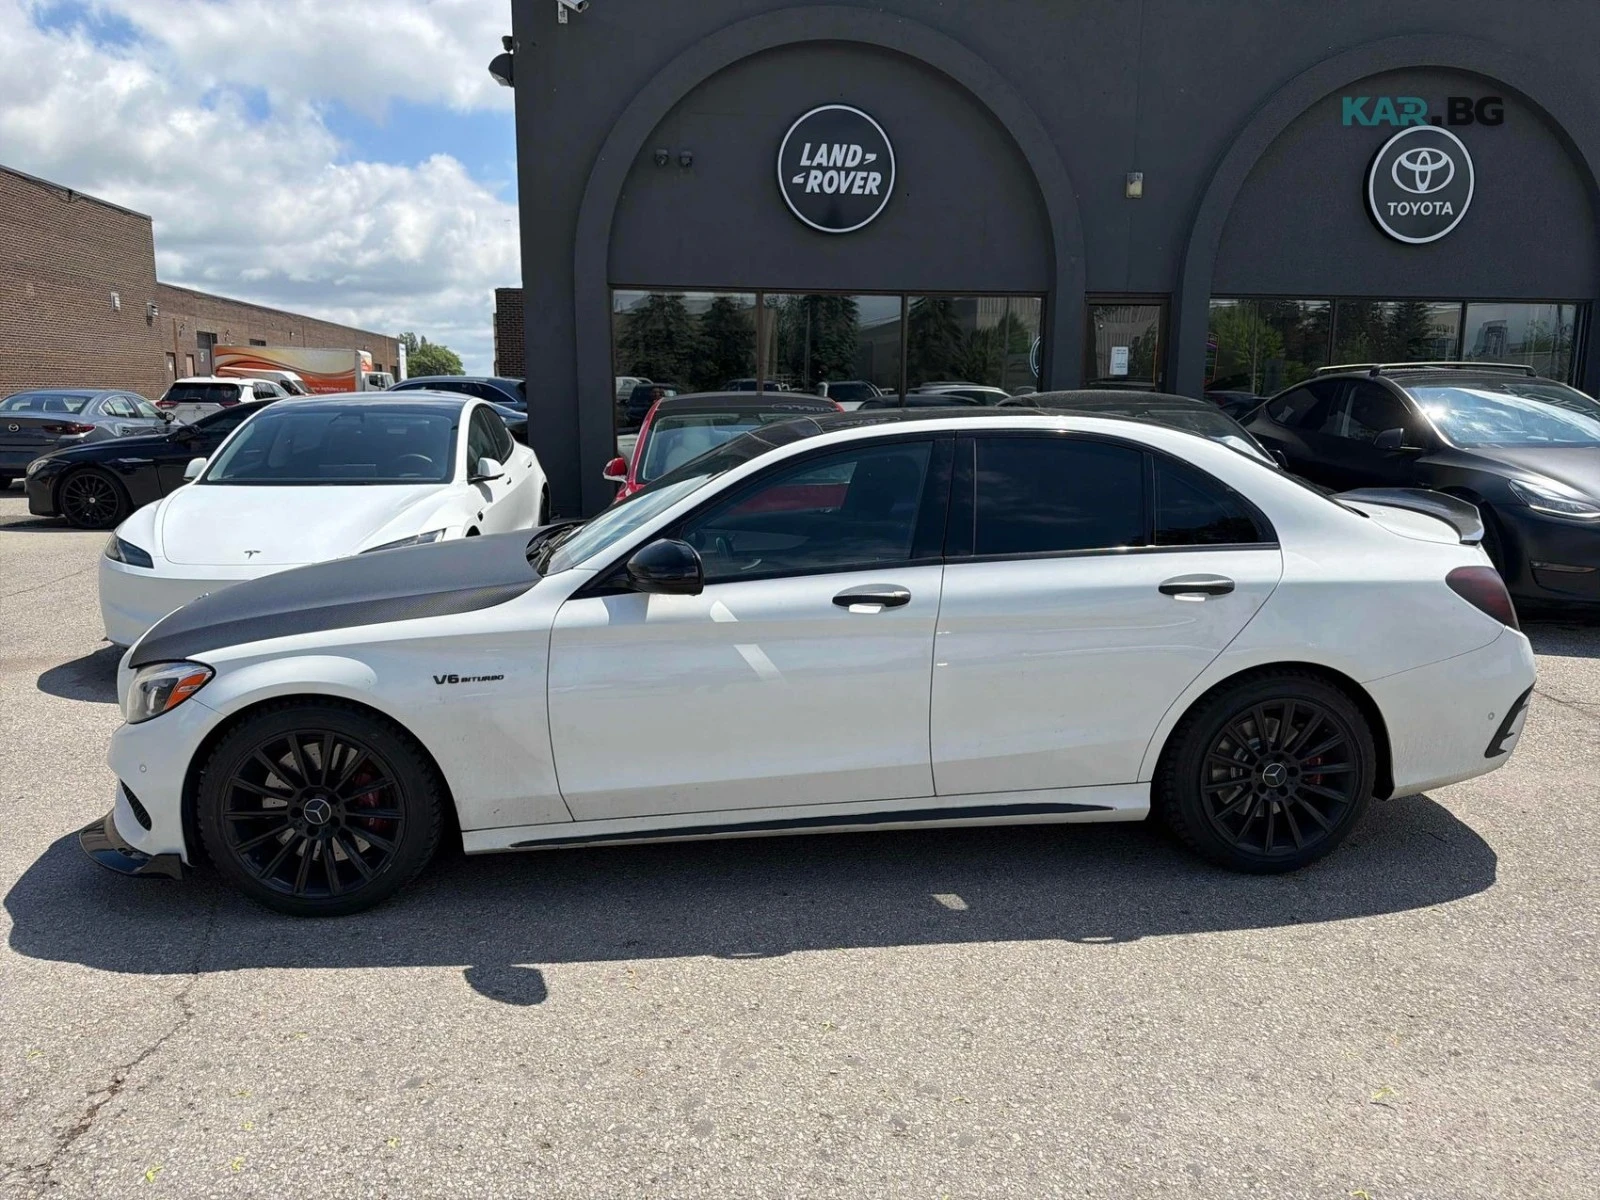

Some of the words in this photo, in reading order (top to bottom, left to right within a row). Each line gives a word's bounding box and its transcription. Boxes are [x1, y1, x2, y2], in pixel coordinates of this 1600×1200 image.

[800, 142, 863, 168] LAND
[805, 169, 882, 195] ROVER
[1387, 201, 1454, 216] TOYOTA
[433, 674, 460, 685] V6
[461, 674, 505, 683] BITURBO
